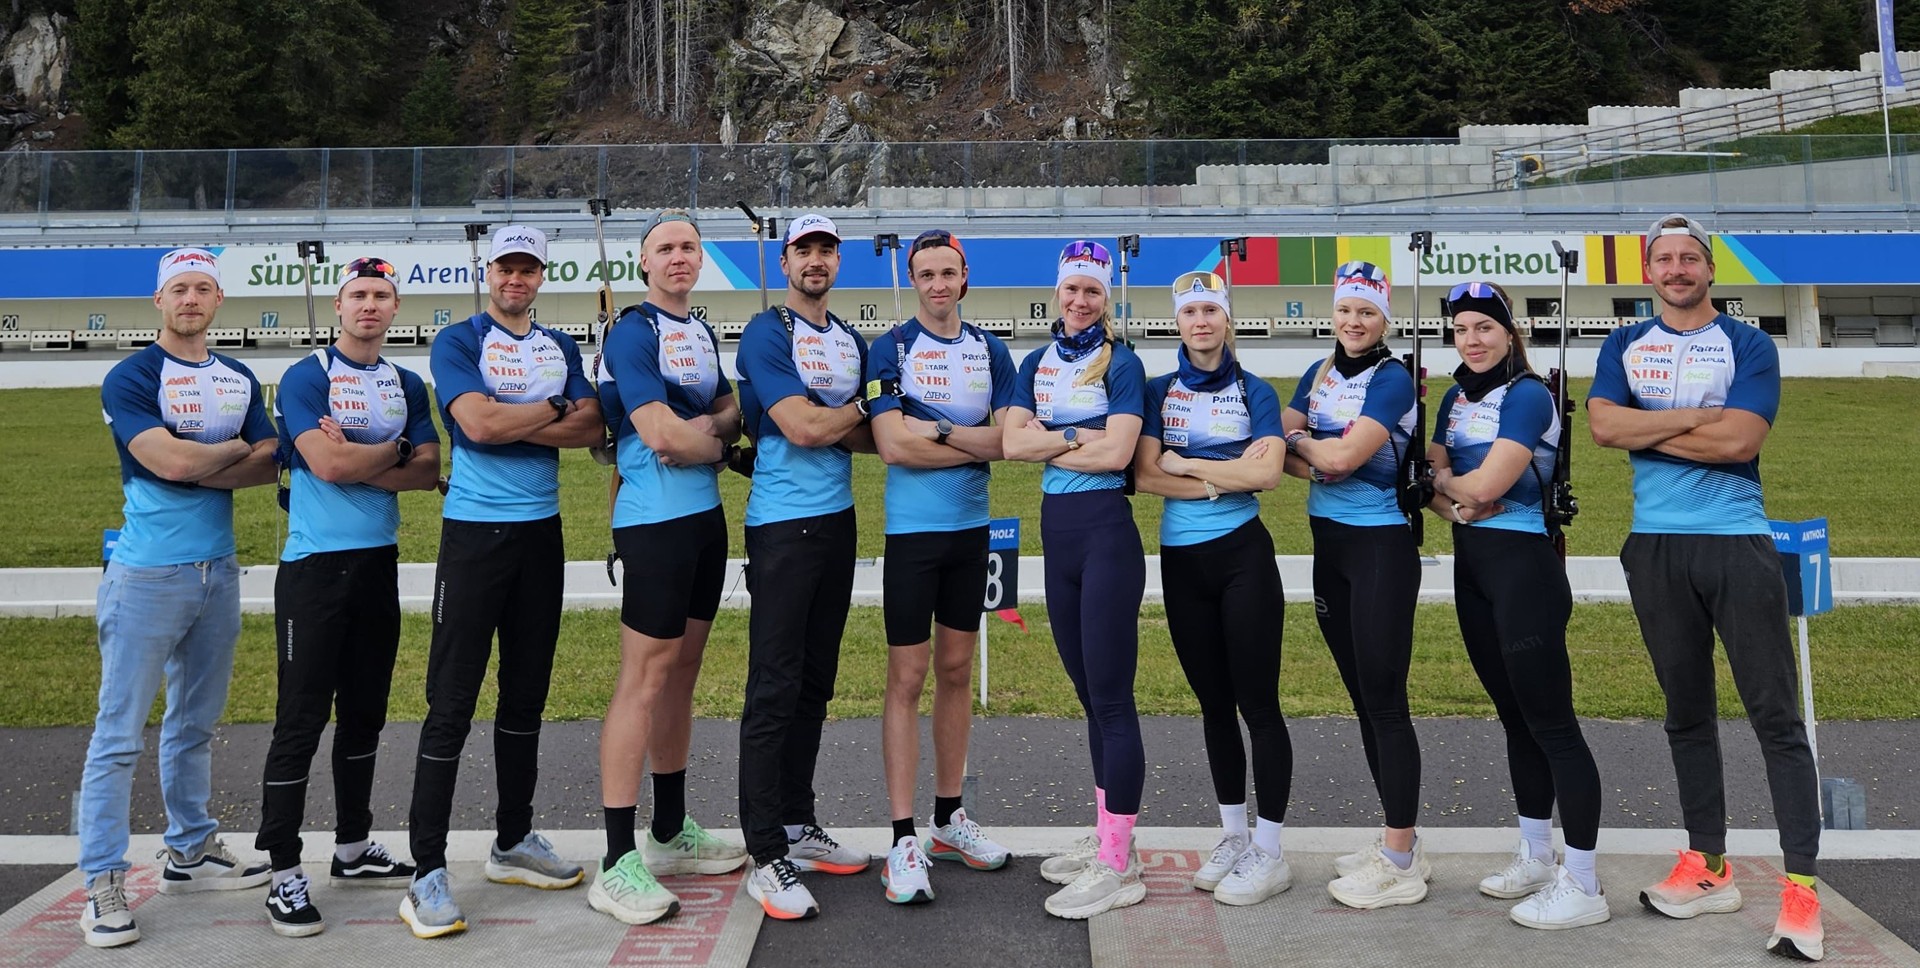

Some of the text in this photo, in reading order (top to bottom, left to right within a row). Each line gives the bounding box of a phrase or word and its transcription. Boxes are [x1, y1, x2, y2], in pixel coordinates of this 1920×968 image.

[800, 218, 828, 231] Rex
[407, 263, 485, 284] Arena
[692, 308, 706, 320] 12
[861, 305, 876, 320] 10
[1034, 304, 1044, 319] 8
[1290, 303, 1299, 318] 5
[1551, 303, 1560, 317] 2
[1727, 302, 1745, 317] 33
[89, 315, 106, 330] 19
[265, 313, 279, 328] 17
[435, 310, 451, 325] 15
[2, 316, 19, 331] 20
[1682, 322, 1715, 336] noname
[1634, 344, 1673, 353] AVANT
[1689, 344, 1724, 353] Patria
[499, 355, 523, 363] STARK
[913, 350, 947, 360] AVANT
[670, 357, 698, 368] NIBE
[801, 361, 832, 372] NIBE
[1643, 357, 1673, 365] STARK
[489, 366, 527, 377] NIBE
[1632, 369, 1672, 380] NIBE
[166, 376, 196, 386] AVANT
[211, 376, 241, 385] Patria
[331, 374, 361, 385] AVANT
[915, 376, 951, 387] NIBE
[342, 388, 366, 396] STARK
[924, 390, 951, 400] ATENO
[1641, 385, 1671, 395] ATENO
[170, 403, 203, 414] NIBE
[332, 401, 369, 411] NIBE
[1167, 404, 1192, 413] STARK
[1220, 409, 1248, 417] LAPUA
[1771, 531, 1790, 541] LVA
[1802, 528, 1826, 542] ANTHOLZ
[984, 552, 1003, 609] 8
[1809, 553, 1821, 611] 7
[437, 581, 446, 624] noname
